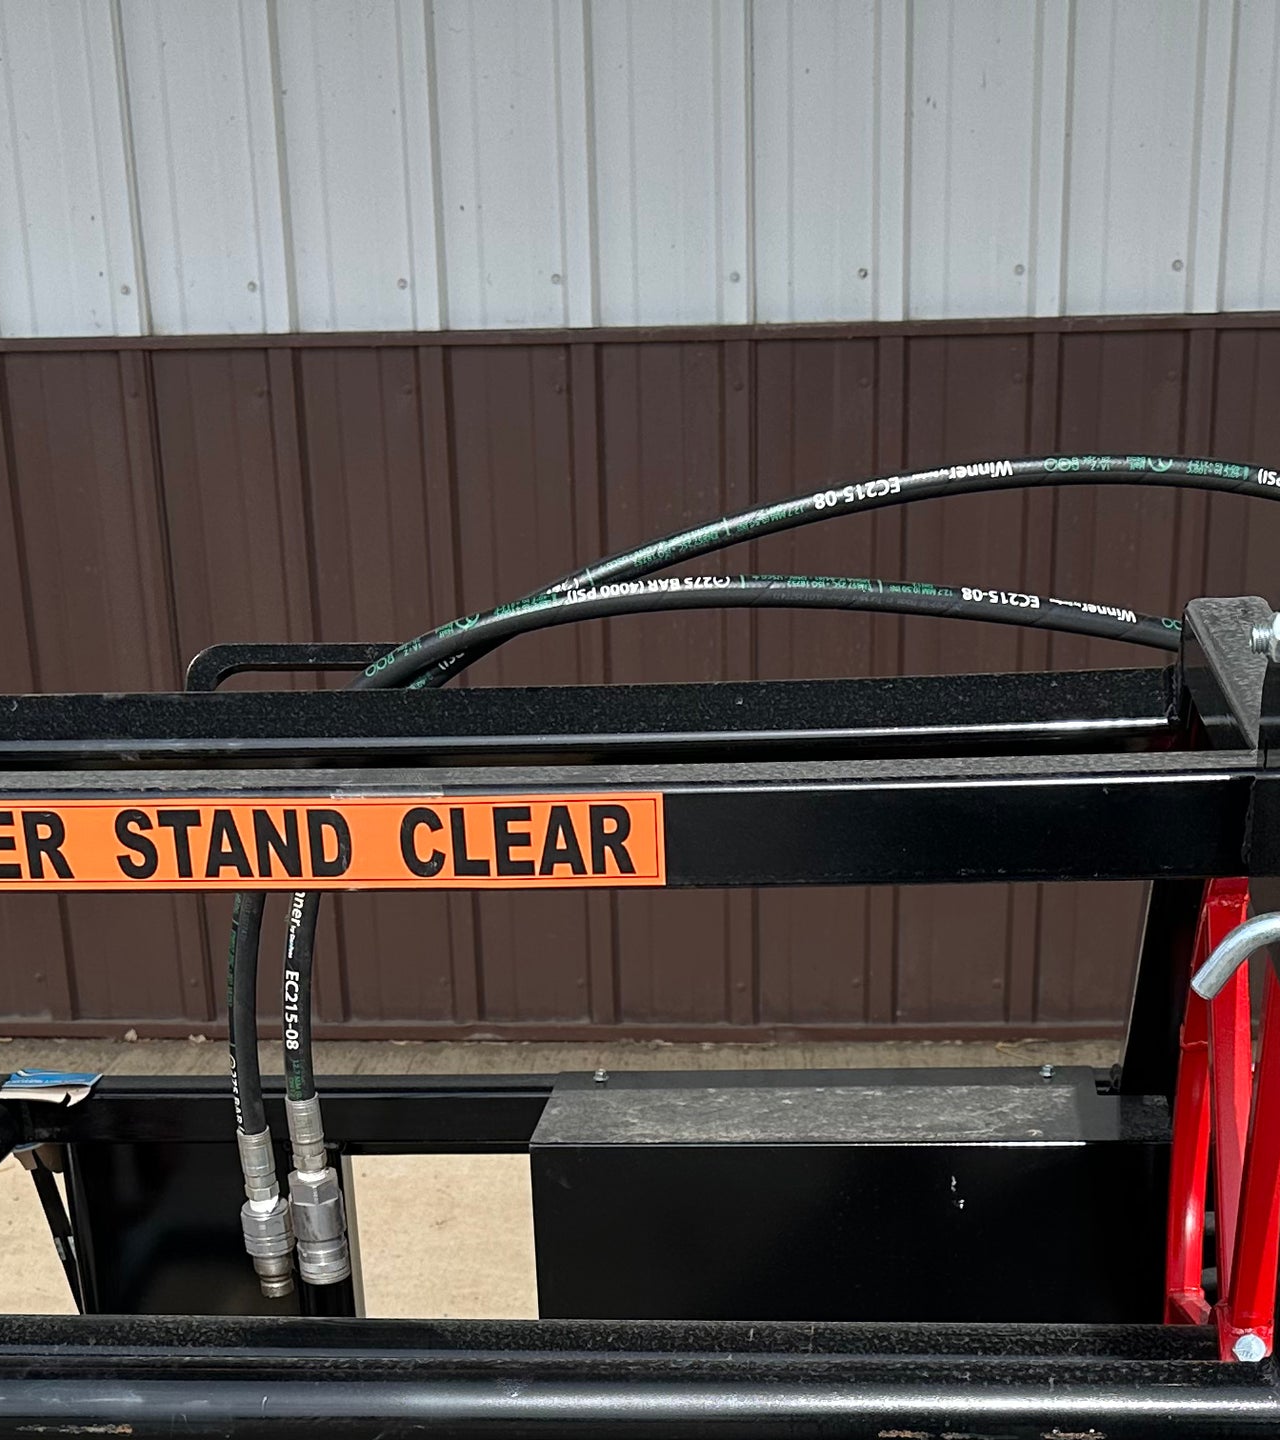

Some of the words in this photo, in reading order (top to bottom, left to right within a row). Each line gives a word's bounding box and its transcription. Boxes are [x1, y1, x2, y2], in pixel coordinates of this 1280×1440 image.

[948, 460, 1013, 480] Winner
[814, 476, 902, 511] EC215-08
[601, 581, 645, 598] (4000
[648, 578, 681, 592] BAR
[683, 576, 714, 589] 275
[566, 587, 598, 605] PSI)
[961, 587, 1041, 608] EC215-08
[1081, 602, 1137, 623] Winner
[115, 808, 351, 880] STAND
[398, 804, 636, 878] CLEAR
[290, 891, 306, 928] nner
[284, 970, 301, 1050] EC215-08
